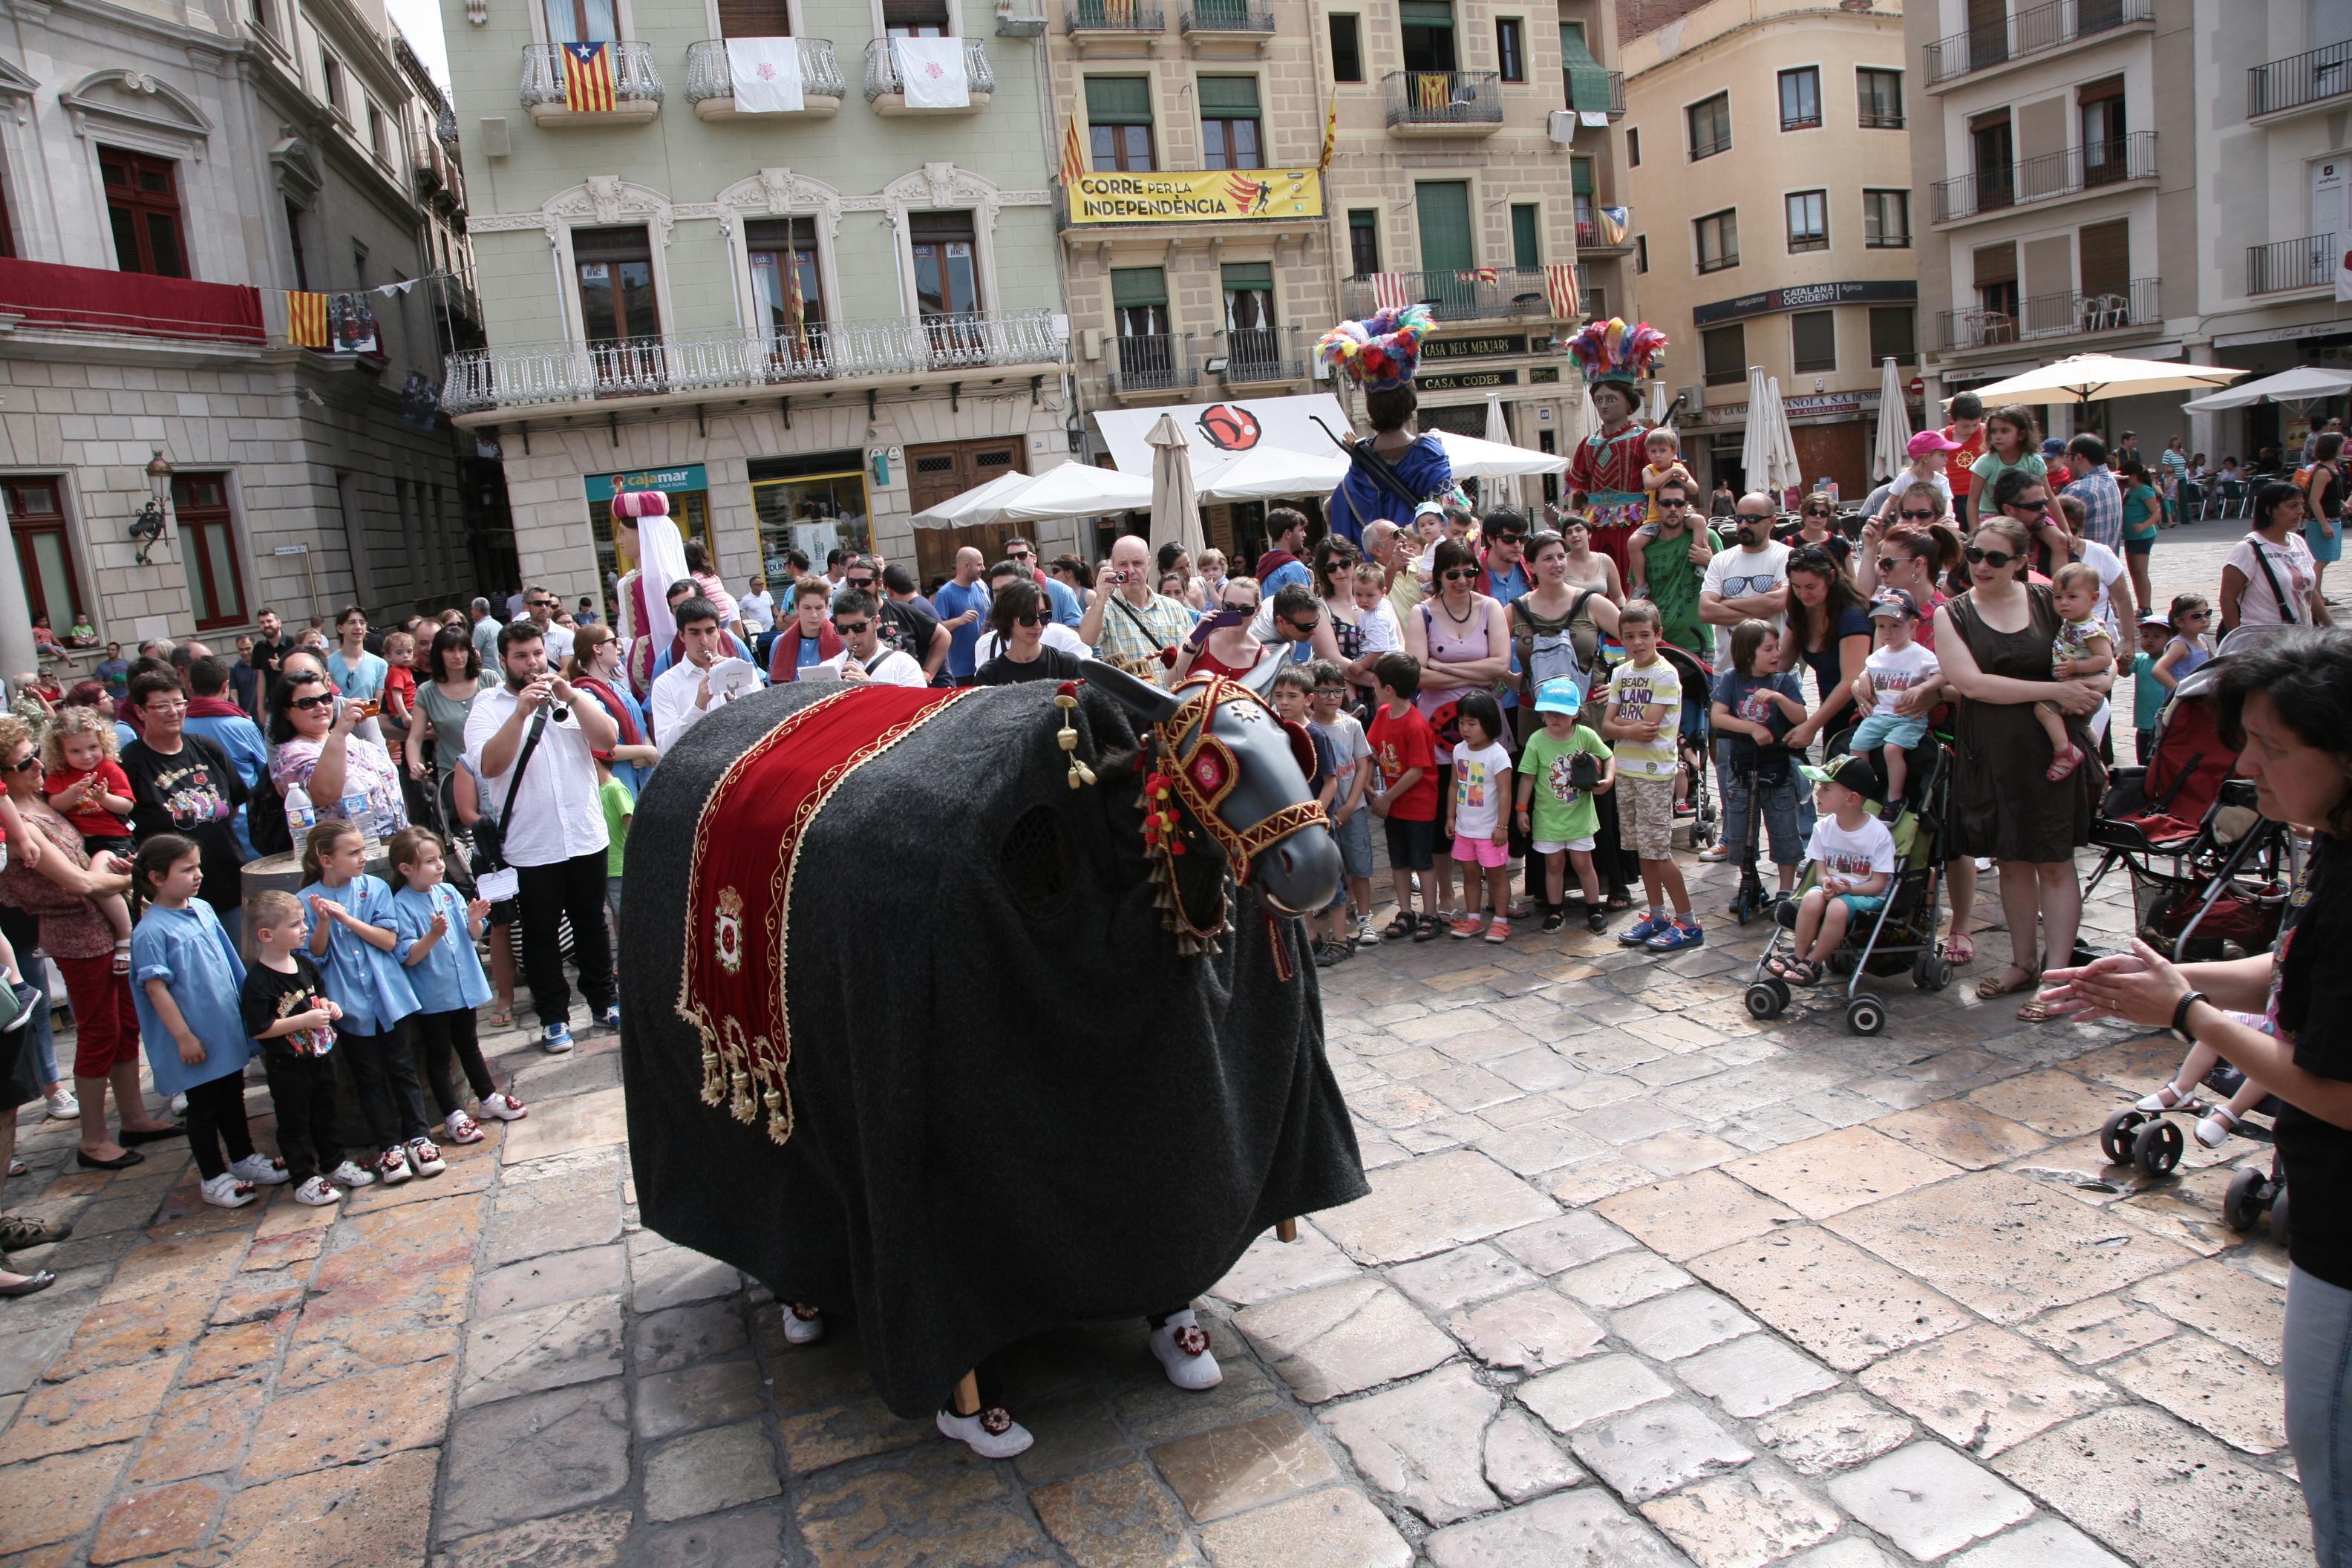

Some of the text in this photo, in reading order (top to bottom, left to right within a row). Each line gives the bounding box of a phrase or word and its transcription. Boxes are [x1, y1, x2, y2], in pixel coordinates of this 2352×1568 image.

[1081, 179, 1192, 195] CORRE PER LA
[1084, 195, 1226, 216] INDEPENDÈNCIA
[1783, 284, 1835, 298] CATALANA
[1783, 292, 1835, 306] OCCIDENT
[1425, 339, 1509, 357] CASA DELS MENJARS
[1425, 374, 1501, 390] CASA CODER
[1830, 393, 1851, 404] S.A.
[1852, 393, 1863, 402] DE
[628, 471, 688, 488] cajamar
[1621, 677, 1649, 687] BEACH
[1621, 705, 1644, 719] ARK
